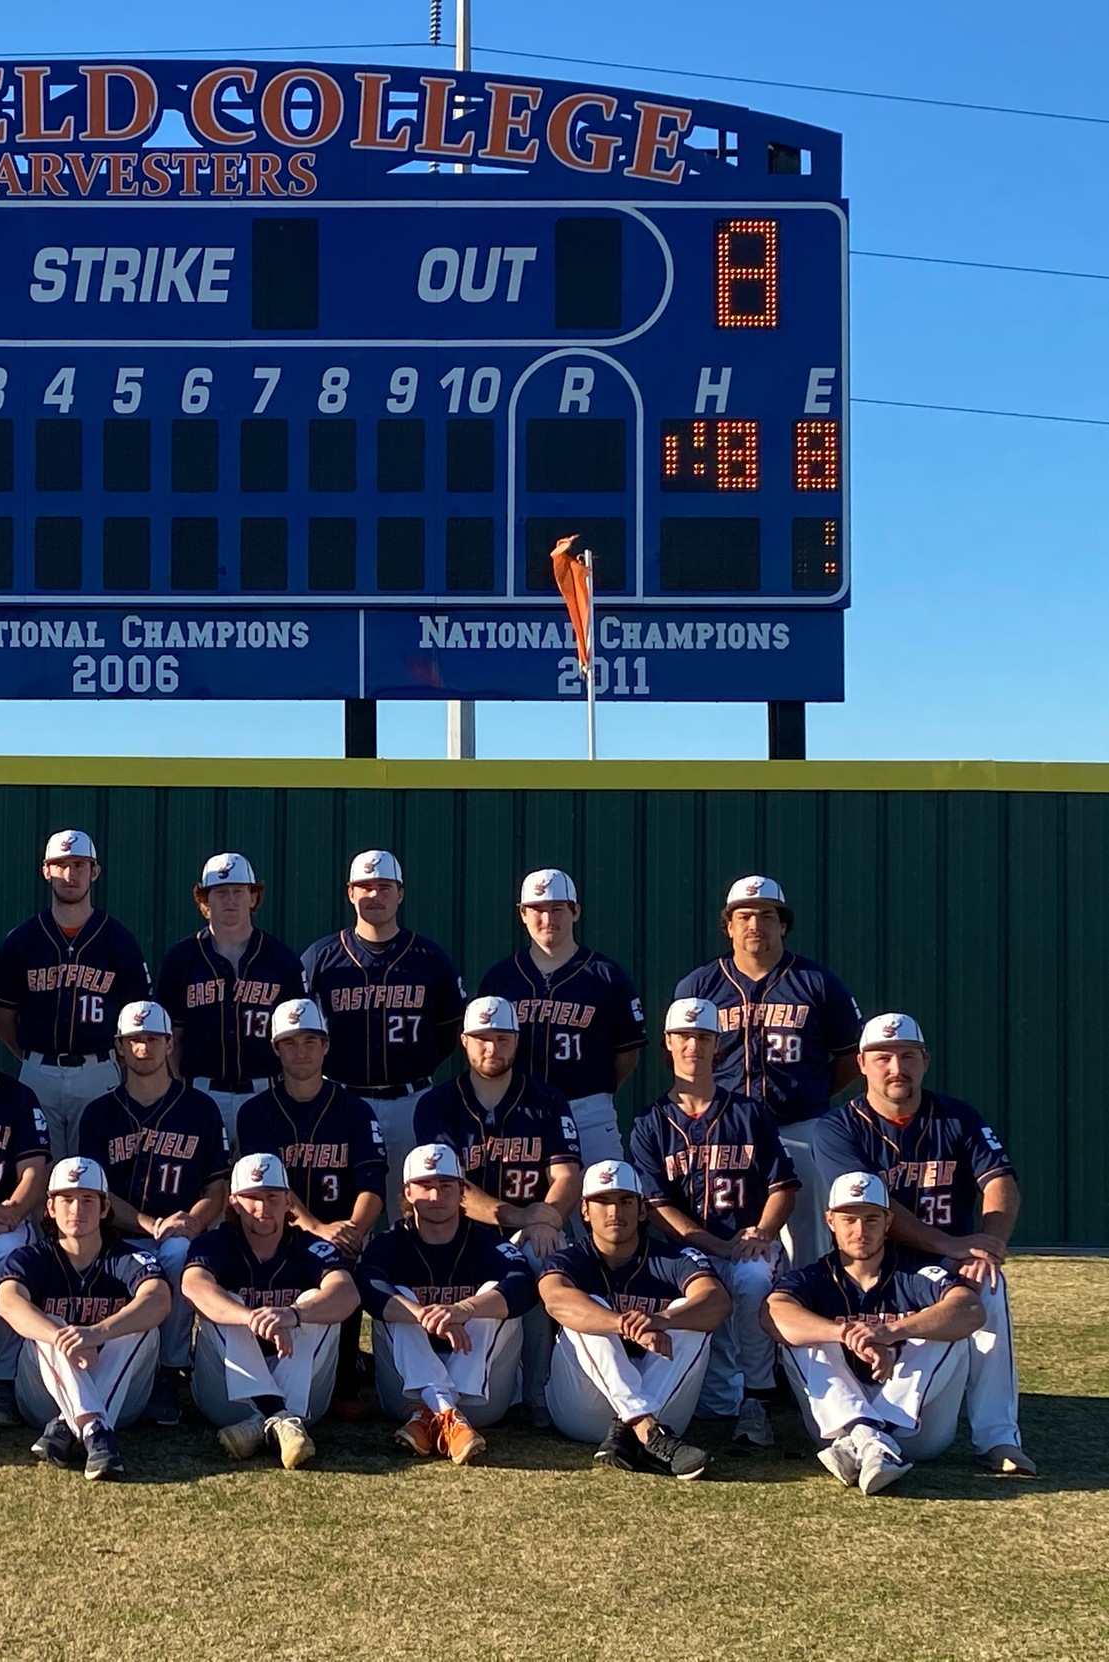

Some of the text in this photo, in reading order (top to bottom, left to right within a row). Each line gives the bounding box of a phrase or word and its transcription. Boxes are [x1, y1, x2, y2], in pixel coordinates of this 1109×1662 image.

[190, 66, 693, 186] COLLEGE
[29, 245, 235, 304] STRIKE
[416, 246, 538, 304] OUT
[42, 366, 76, 414] 4
[111, 367, 145, 414] 5
[180, 367, 214, 414] 6
[251, 367, 282, 414] 7
[316, 367, 351, 414] 8
[385, 367, 420, 414] 9
[439, 367, 503, 414] 10
[557, 366, 596, 414] R
[693, 366, 733, 414] H
[803, 366, 837, 414] E
[72, 654, 180, 694] 2006
[557, 656, 650, 694] 2011
[26, 963, 116, 995] EASTFIELD
[186, 978, 281, 1009] EASTFIELD
[78, 995, 104, 1024] 16
[330, 984, 426, 1012] EASTFIELD
[245, 1009, 270, 1038] 13
[388, 1015, 422, 1044] 27
[718, 1002, 810, 1033] ASTFIELD
[554, 1033, 582, 1061] 31
[159, 1162, 183, 1194] 11
[322, 1174, 339, 1203] 3
[505, 1169, 540, 1199] 32
[714, 1176, 745, 1208] 21
[920, 1194, 952, 1226] 35
